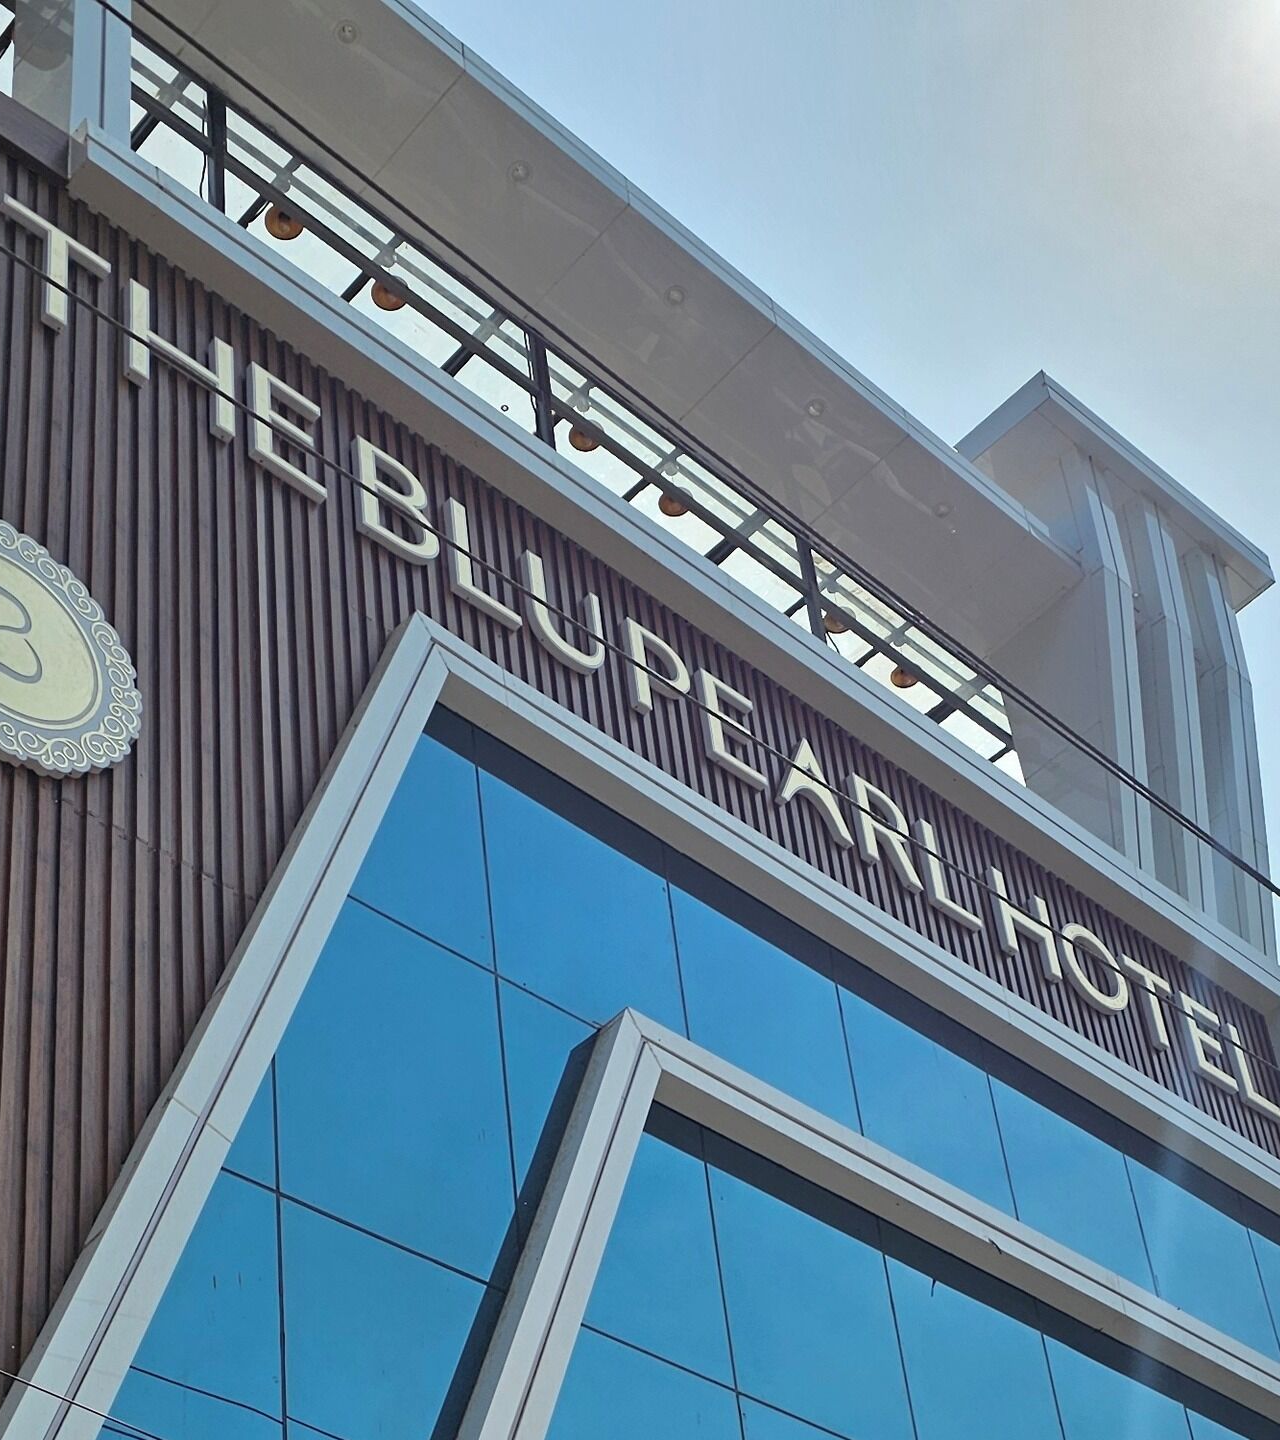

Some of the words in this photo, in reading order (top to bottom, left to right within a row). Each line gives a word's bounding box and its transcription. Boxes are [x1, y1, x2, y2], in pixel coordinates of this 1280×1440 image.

[1, 194, 328, 504] THE
[352, 435, 608, 676] BLU
[624, 617, 983, 933] PEARL
